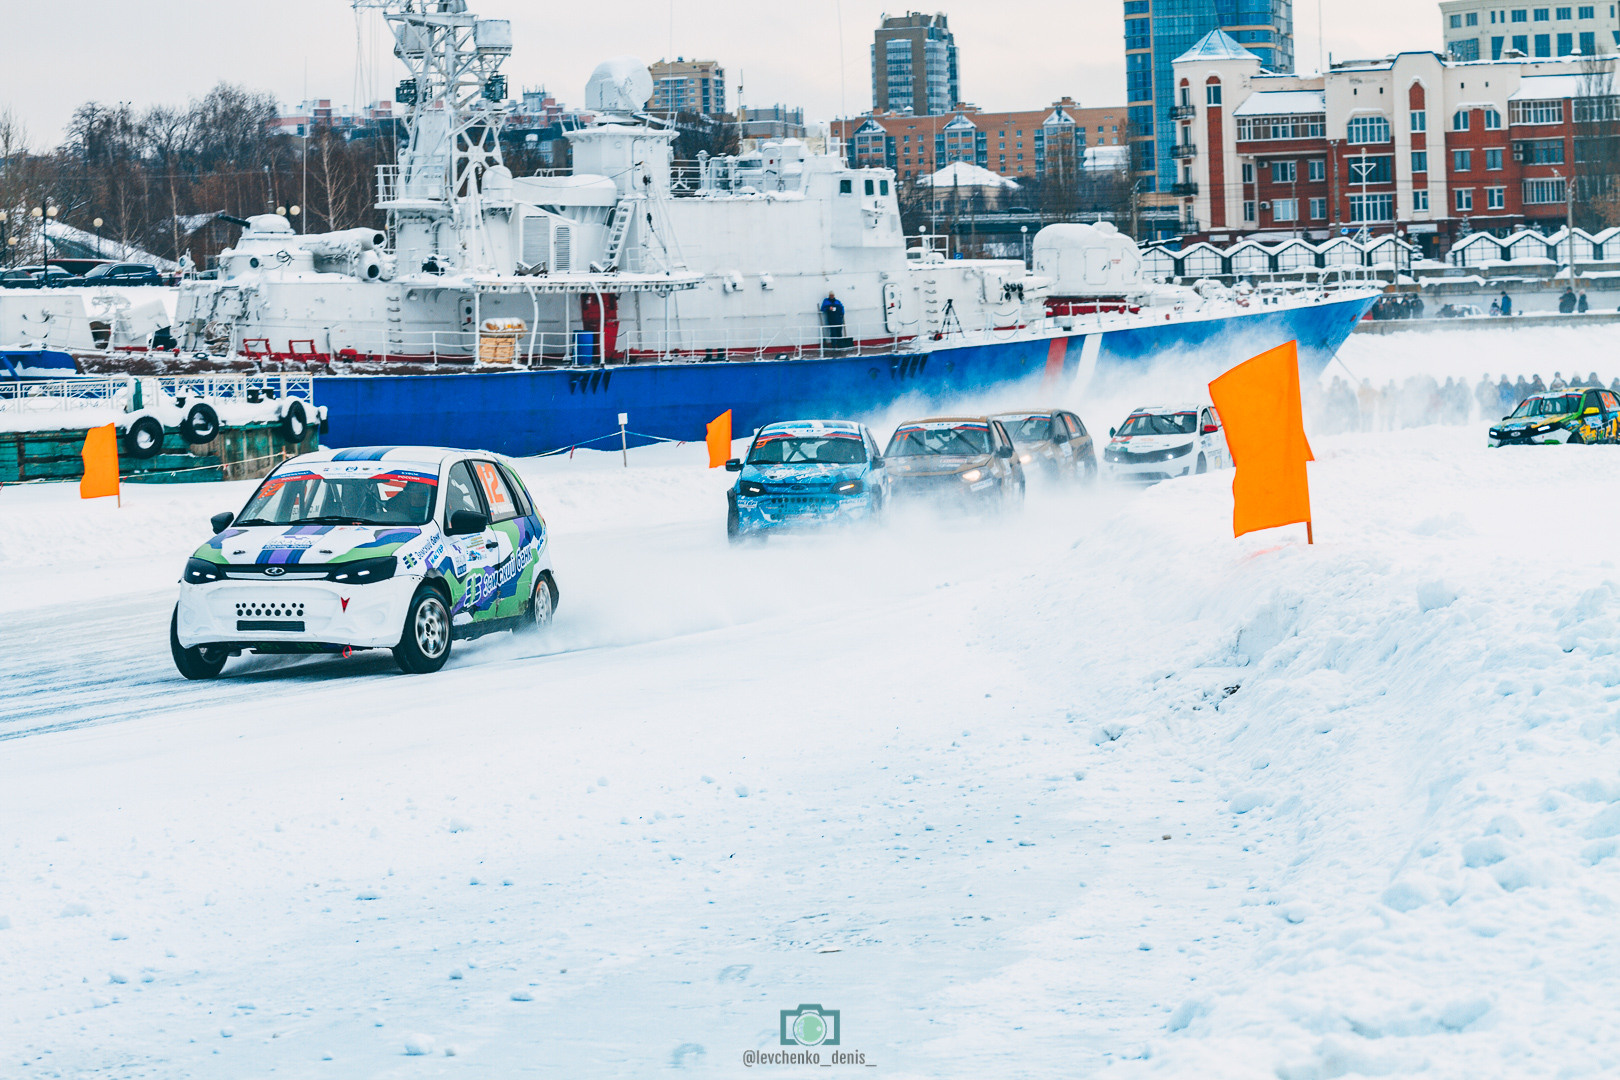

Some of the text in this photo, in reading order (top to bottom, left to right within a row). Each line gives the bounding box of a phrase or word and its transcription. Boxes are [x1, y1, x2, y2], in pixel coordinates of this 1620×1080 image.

[1601, 392, 1617, 408] 84
[755, 439, 773, 449] 9
[895, 433, 910, 442] 11
[257, 482, 286, 499] 12
[476, 463, 505, 504] 12
[483, 545, 534, 597] Земский банк
